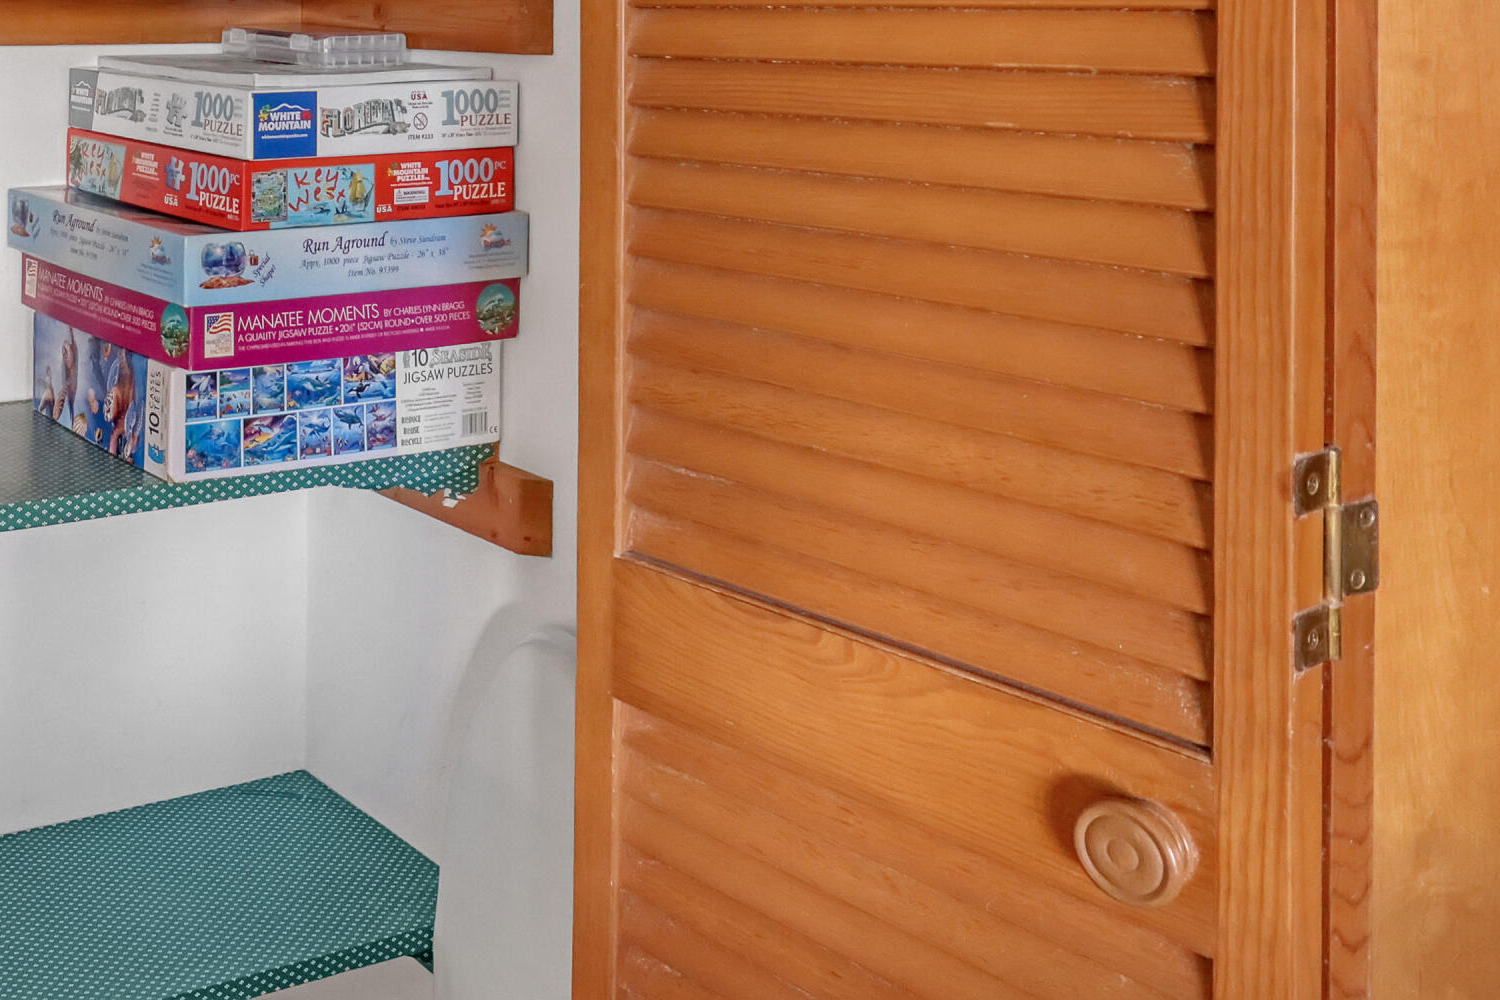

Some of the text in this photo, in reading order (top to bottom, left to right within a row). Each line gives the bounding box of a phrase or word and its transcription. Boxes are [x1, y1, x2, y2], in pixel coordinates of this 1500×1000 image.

[410, 93, 428, 101] USA
[441, 88, 499, 126] 1000
[191, 90, 234, 128] 1000
[269, 111, 301, 121] WHITE
[460, 113, 512, 127] PUZZLE
[203, 118, 243, 137] PUZZLE
[258, 120, 312, 131] MOUNTAIN
[186, 161, 240, 201] 1000 PC
[292, 168, 341, 190] Key
[435, 157, 507, 197] 1000 PC
[164, 195, 179, 207] USA
[199, 191, 240, 214] PUZZLE
[453, 182, 507, 201] PUZZLE
[376, 204, 393, 213] USA
[52, 209, 97, 233] Run Aground
[302, 237, 330, 255] Run
[331, 231, 389, 254] Aground
[389, 236, 399, 246] by
[323, 256, 340, 266] 1000
[343, 257, 359, 267] piece
[387, 251, 409, 261] Puzzle
[38, 266, 67, 289] MANATEE
[67, 277, 104, 302] MOMENTS
[237, 300, 465, 332] MANATEE MOMENTS BY CHARLES LYNN BRAGG
[237, 334, 244, 343] A
[245, 331, 277, 343] QUALITY
[278, 328, 308, 341] JIGSAW
[308, 325, 334, 336] PUZZLE
[384, 317, 411, 328] ROUND
[414, 315, 433, 325] OVER
[433, 313, 448, 324] 500
[448, 311, 471, 322] PIECES
[411, 348, 429, 367] 10
[403, 362, 493, 384] JIGSAW PUZZLES
[148, 411, 160, 435] 10
